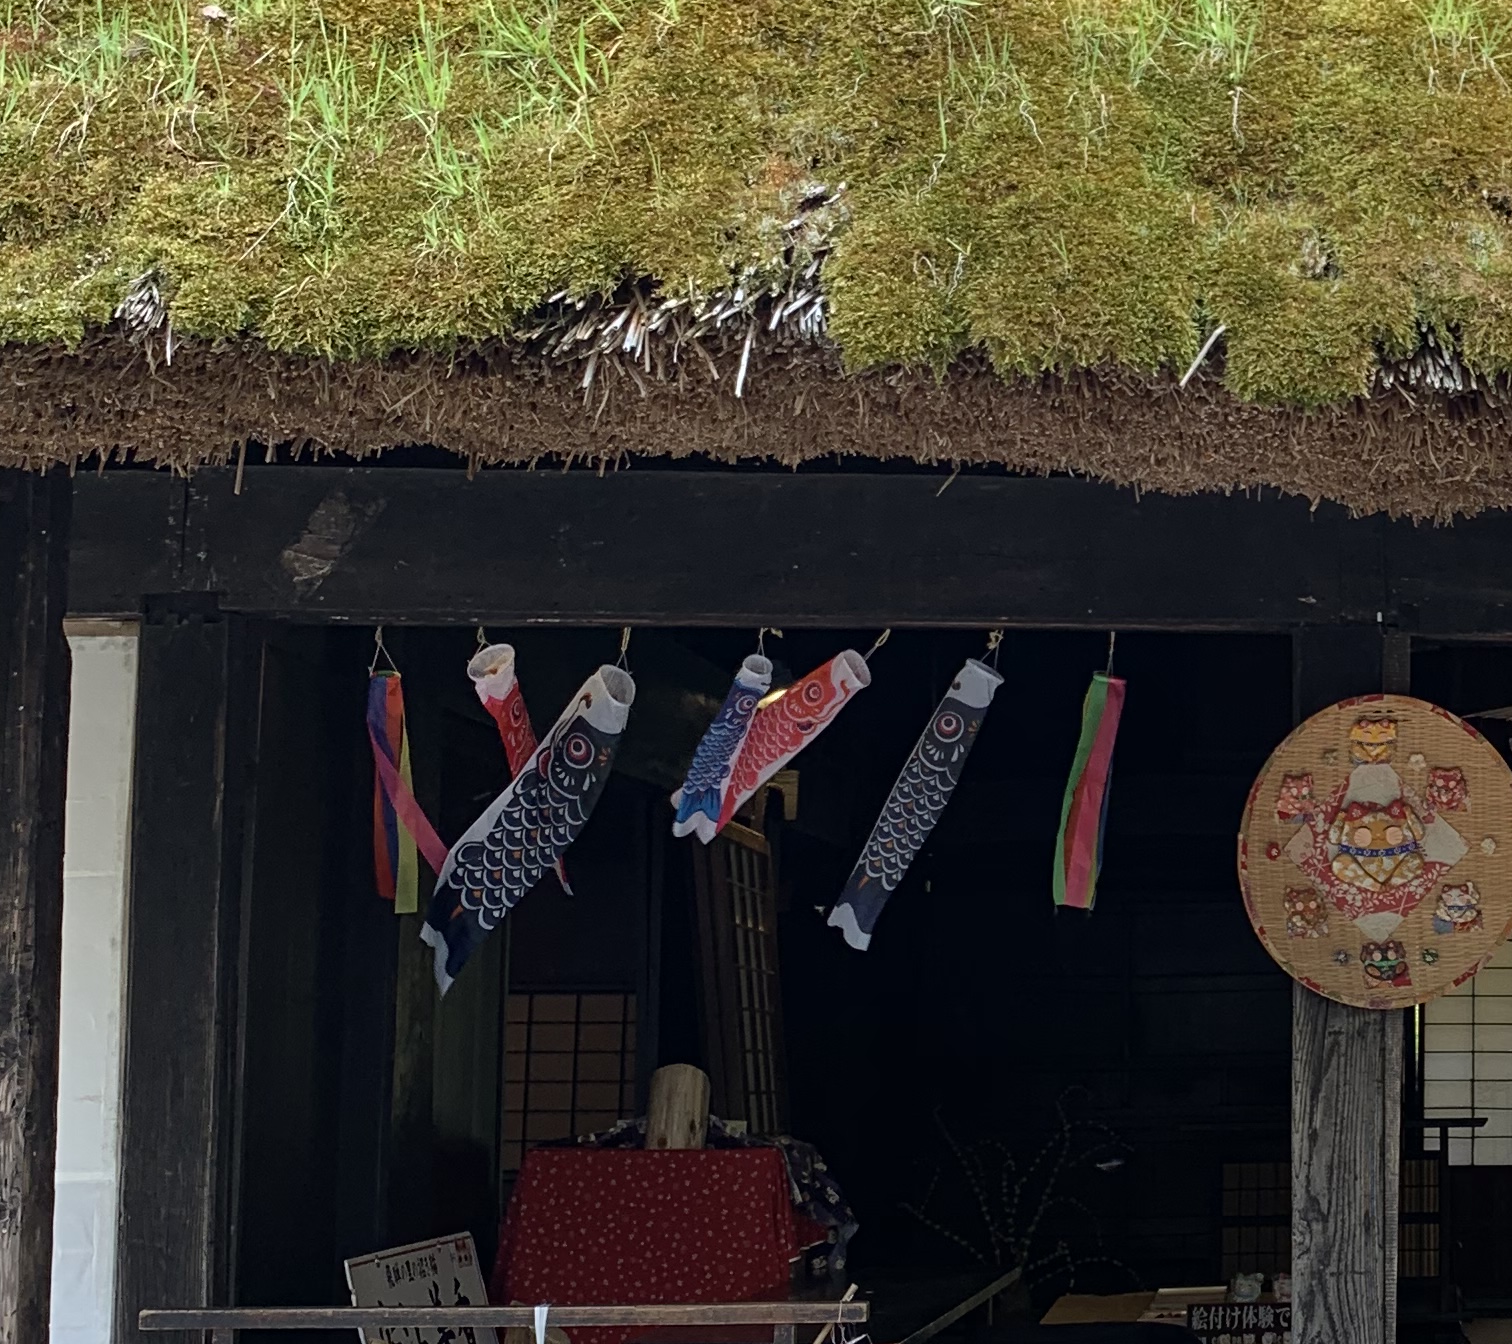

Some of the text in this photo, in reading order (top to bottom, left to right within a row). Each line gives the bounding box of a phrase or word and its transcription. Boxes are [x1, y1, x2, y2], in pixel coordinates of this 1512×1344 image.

[1191, 1305, 1291, 1331] 絵付け体験で
